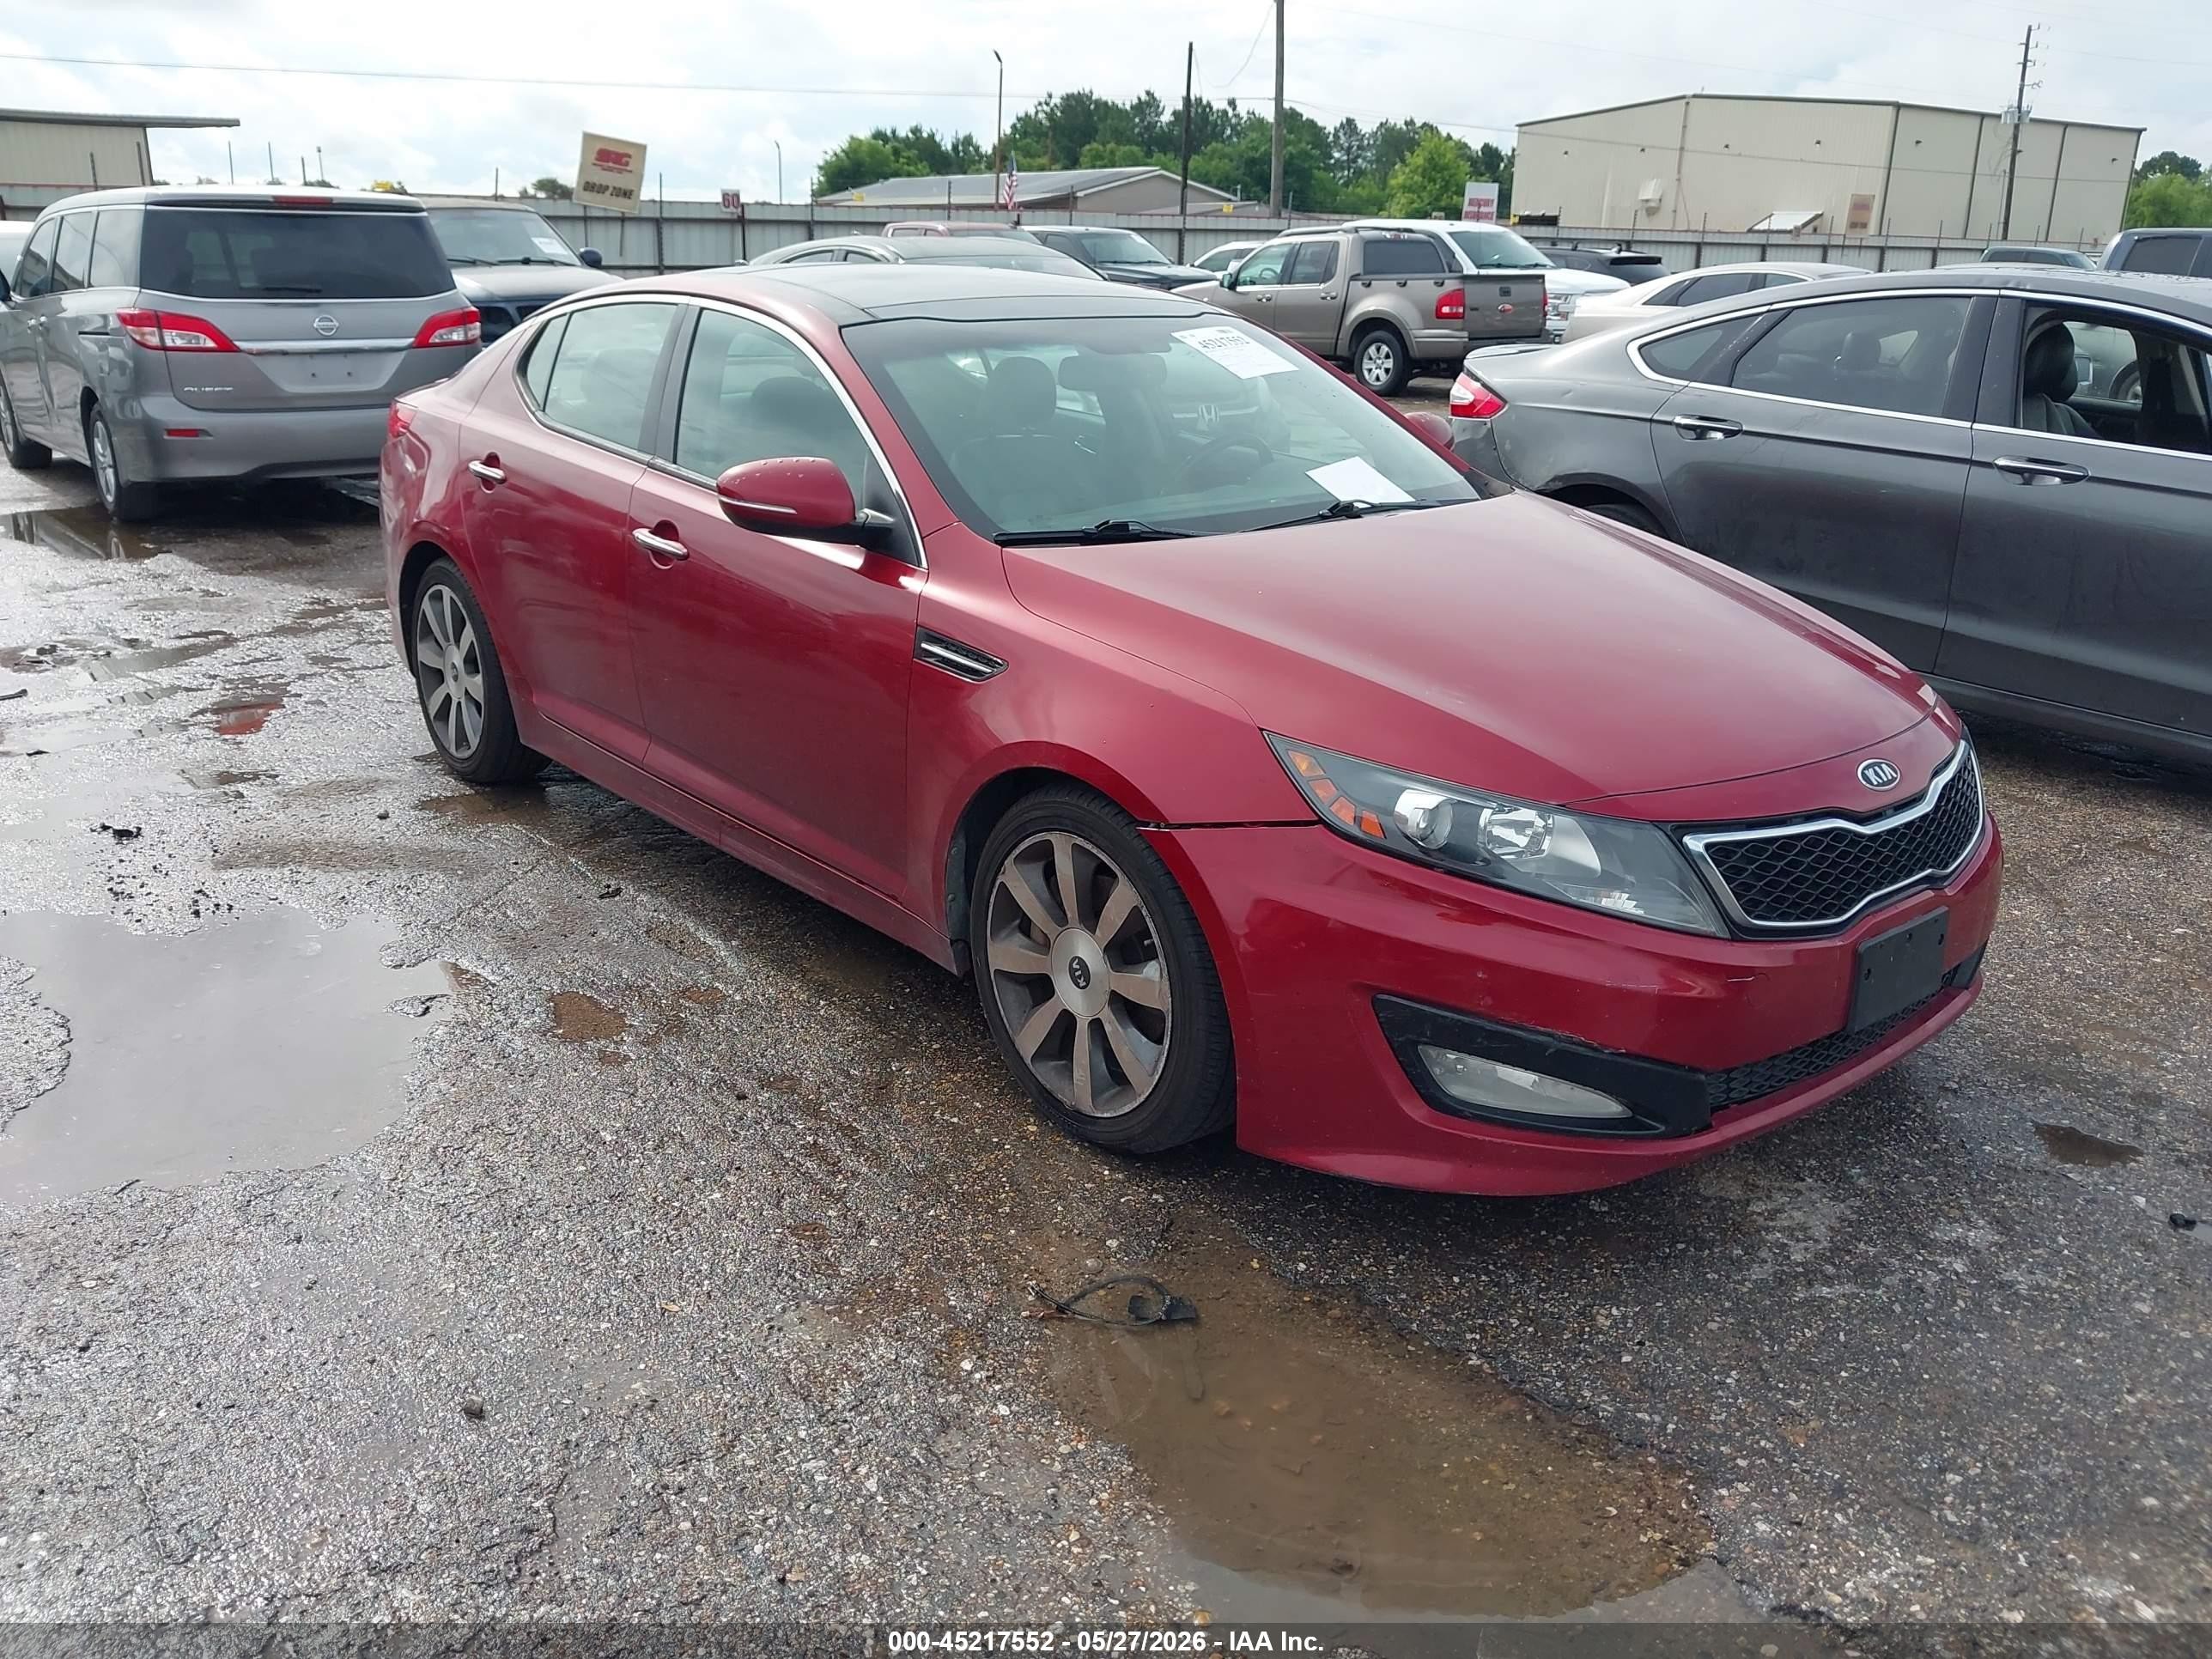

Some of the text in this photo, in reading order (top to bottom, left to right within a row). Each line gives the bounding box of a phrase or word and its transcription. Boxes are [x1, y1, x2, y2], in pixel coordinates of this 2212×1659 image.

[583, 180, 610, 194] DROP
[722, 192, 740, 209] 60
[1863, 763, 1898, 786] KIA
[1072, 957, 1087, 988] KIA
